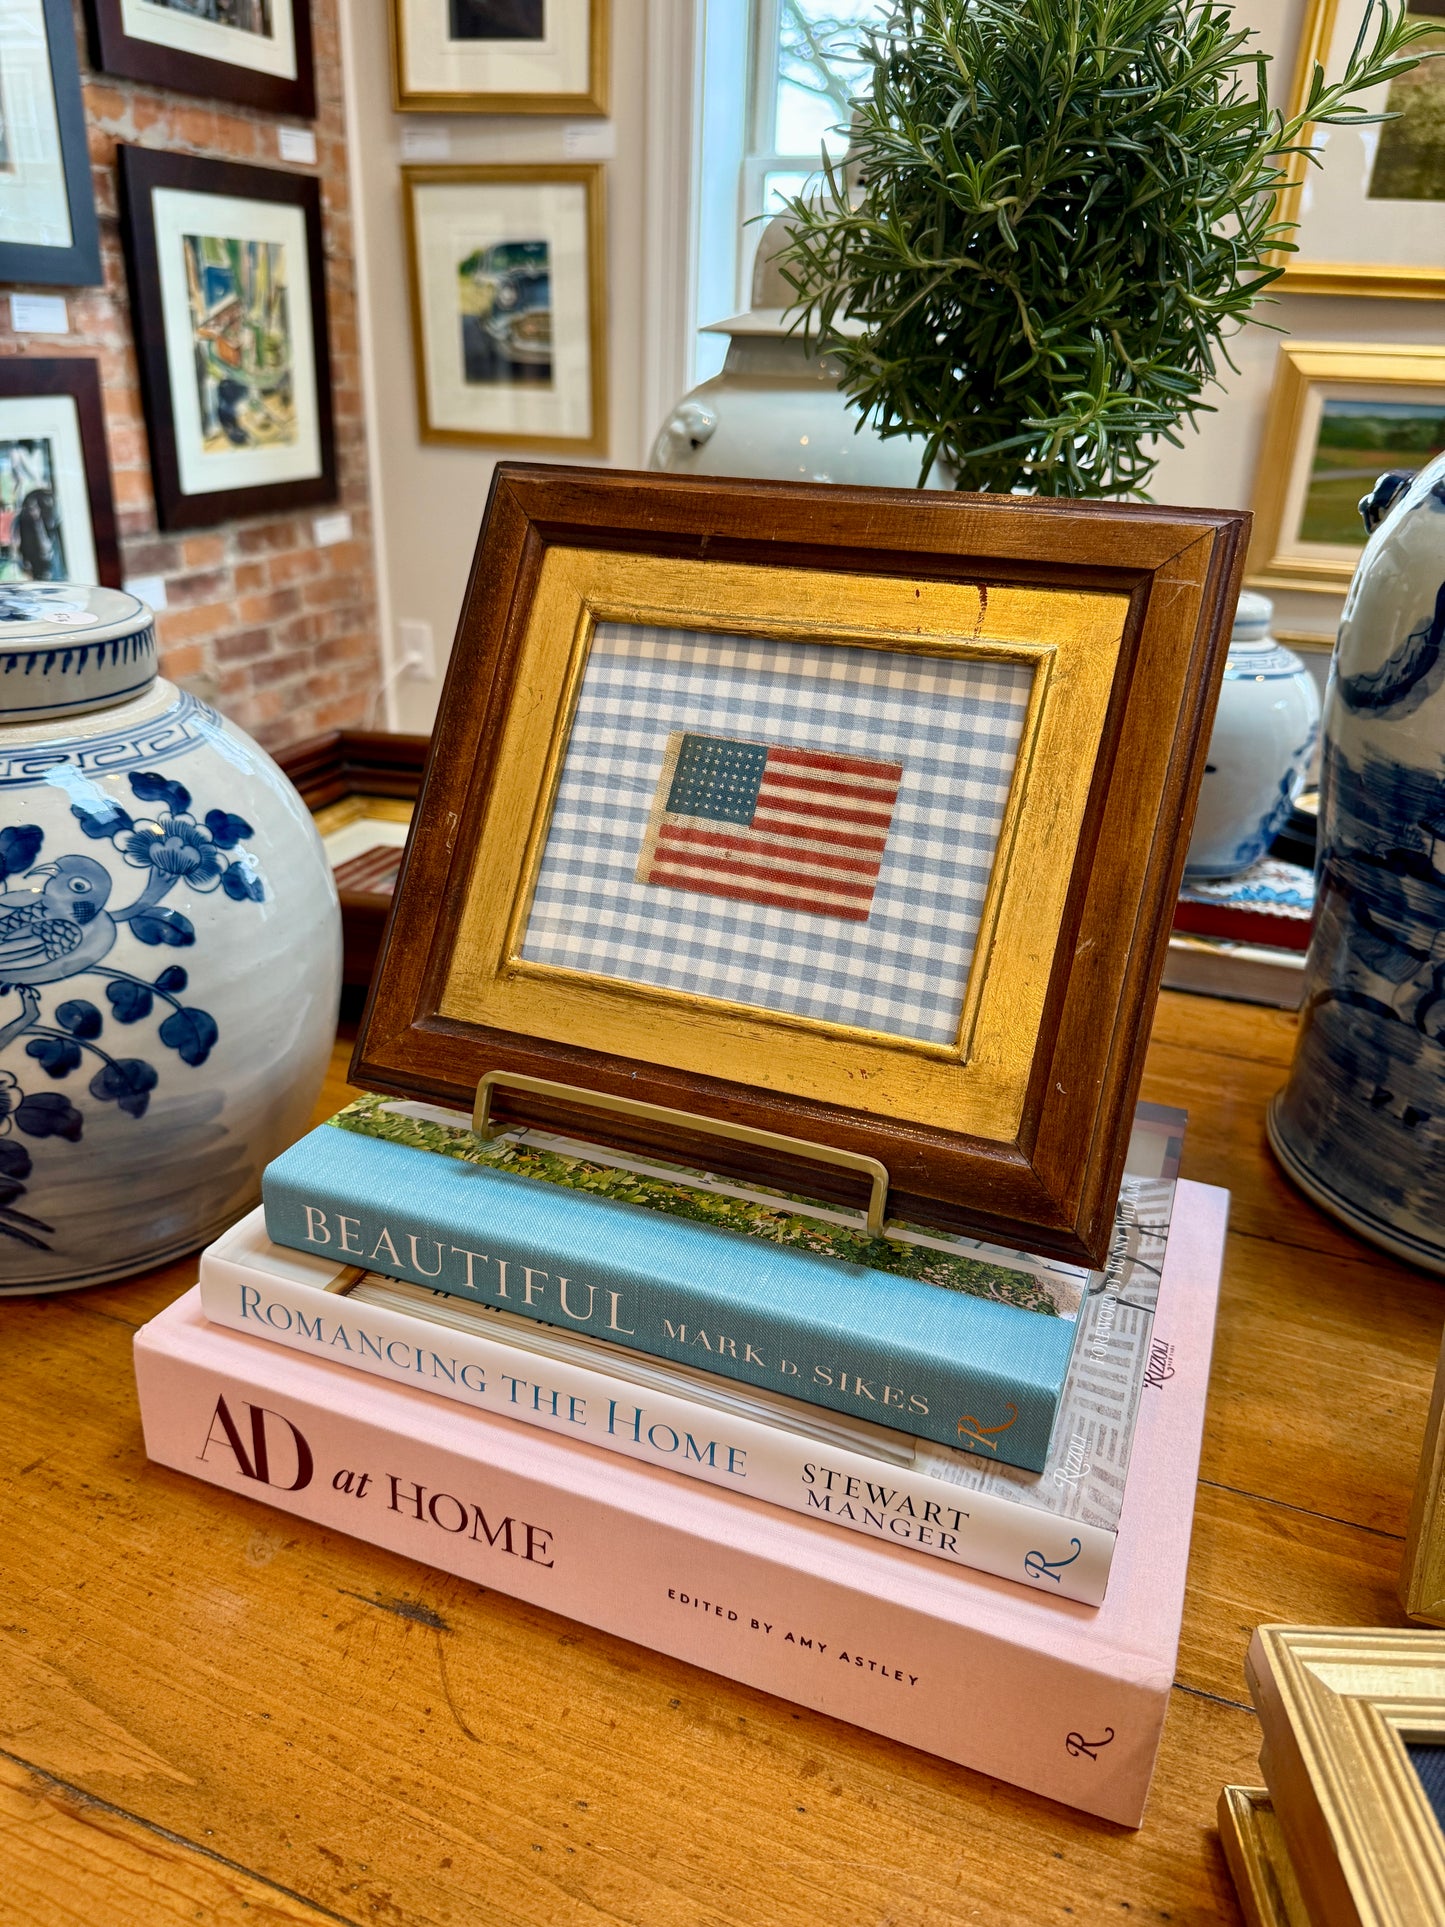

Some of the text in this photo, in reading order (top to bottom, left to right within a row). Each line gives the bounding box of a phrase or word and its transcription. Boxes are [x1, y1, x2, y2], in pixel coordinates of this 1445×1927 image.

[301, 1203, 636, 1336] BEAUTIFUL
[662, 1318, 768, 1368] MARK
[813, 1365, 931, 1416] SIKES
[1089, 1179, 1141, 1365] FOREWORD BY BUNNY WILLIAMS
[239, 1283, 748, 1478] ROMANCING THE HOME
[1141, 1337, 1176, 1391] RIZZOLI
[194, 1392, 556, 1569] AD at HOME
[801, 1462, 970, 1533] STEWART
[1053, 1433, 1091, 1489] RIZZOLI
[804, 1488, 961, 1555] MANGER
[667, 1588, 919, 1686] EDITED BY AMY ASTLEY
